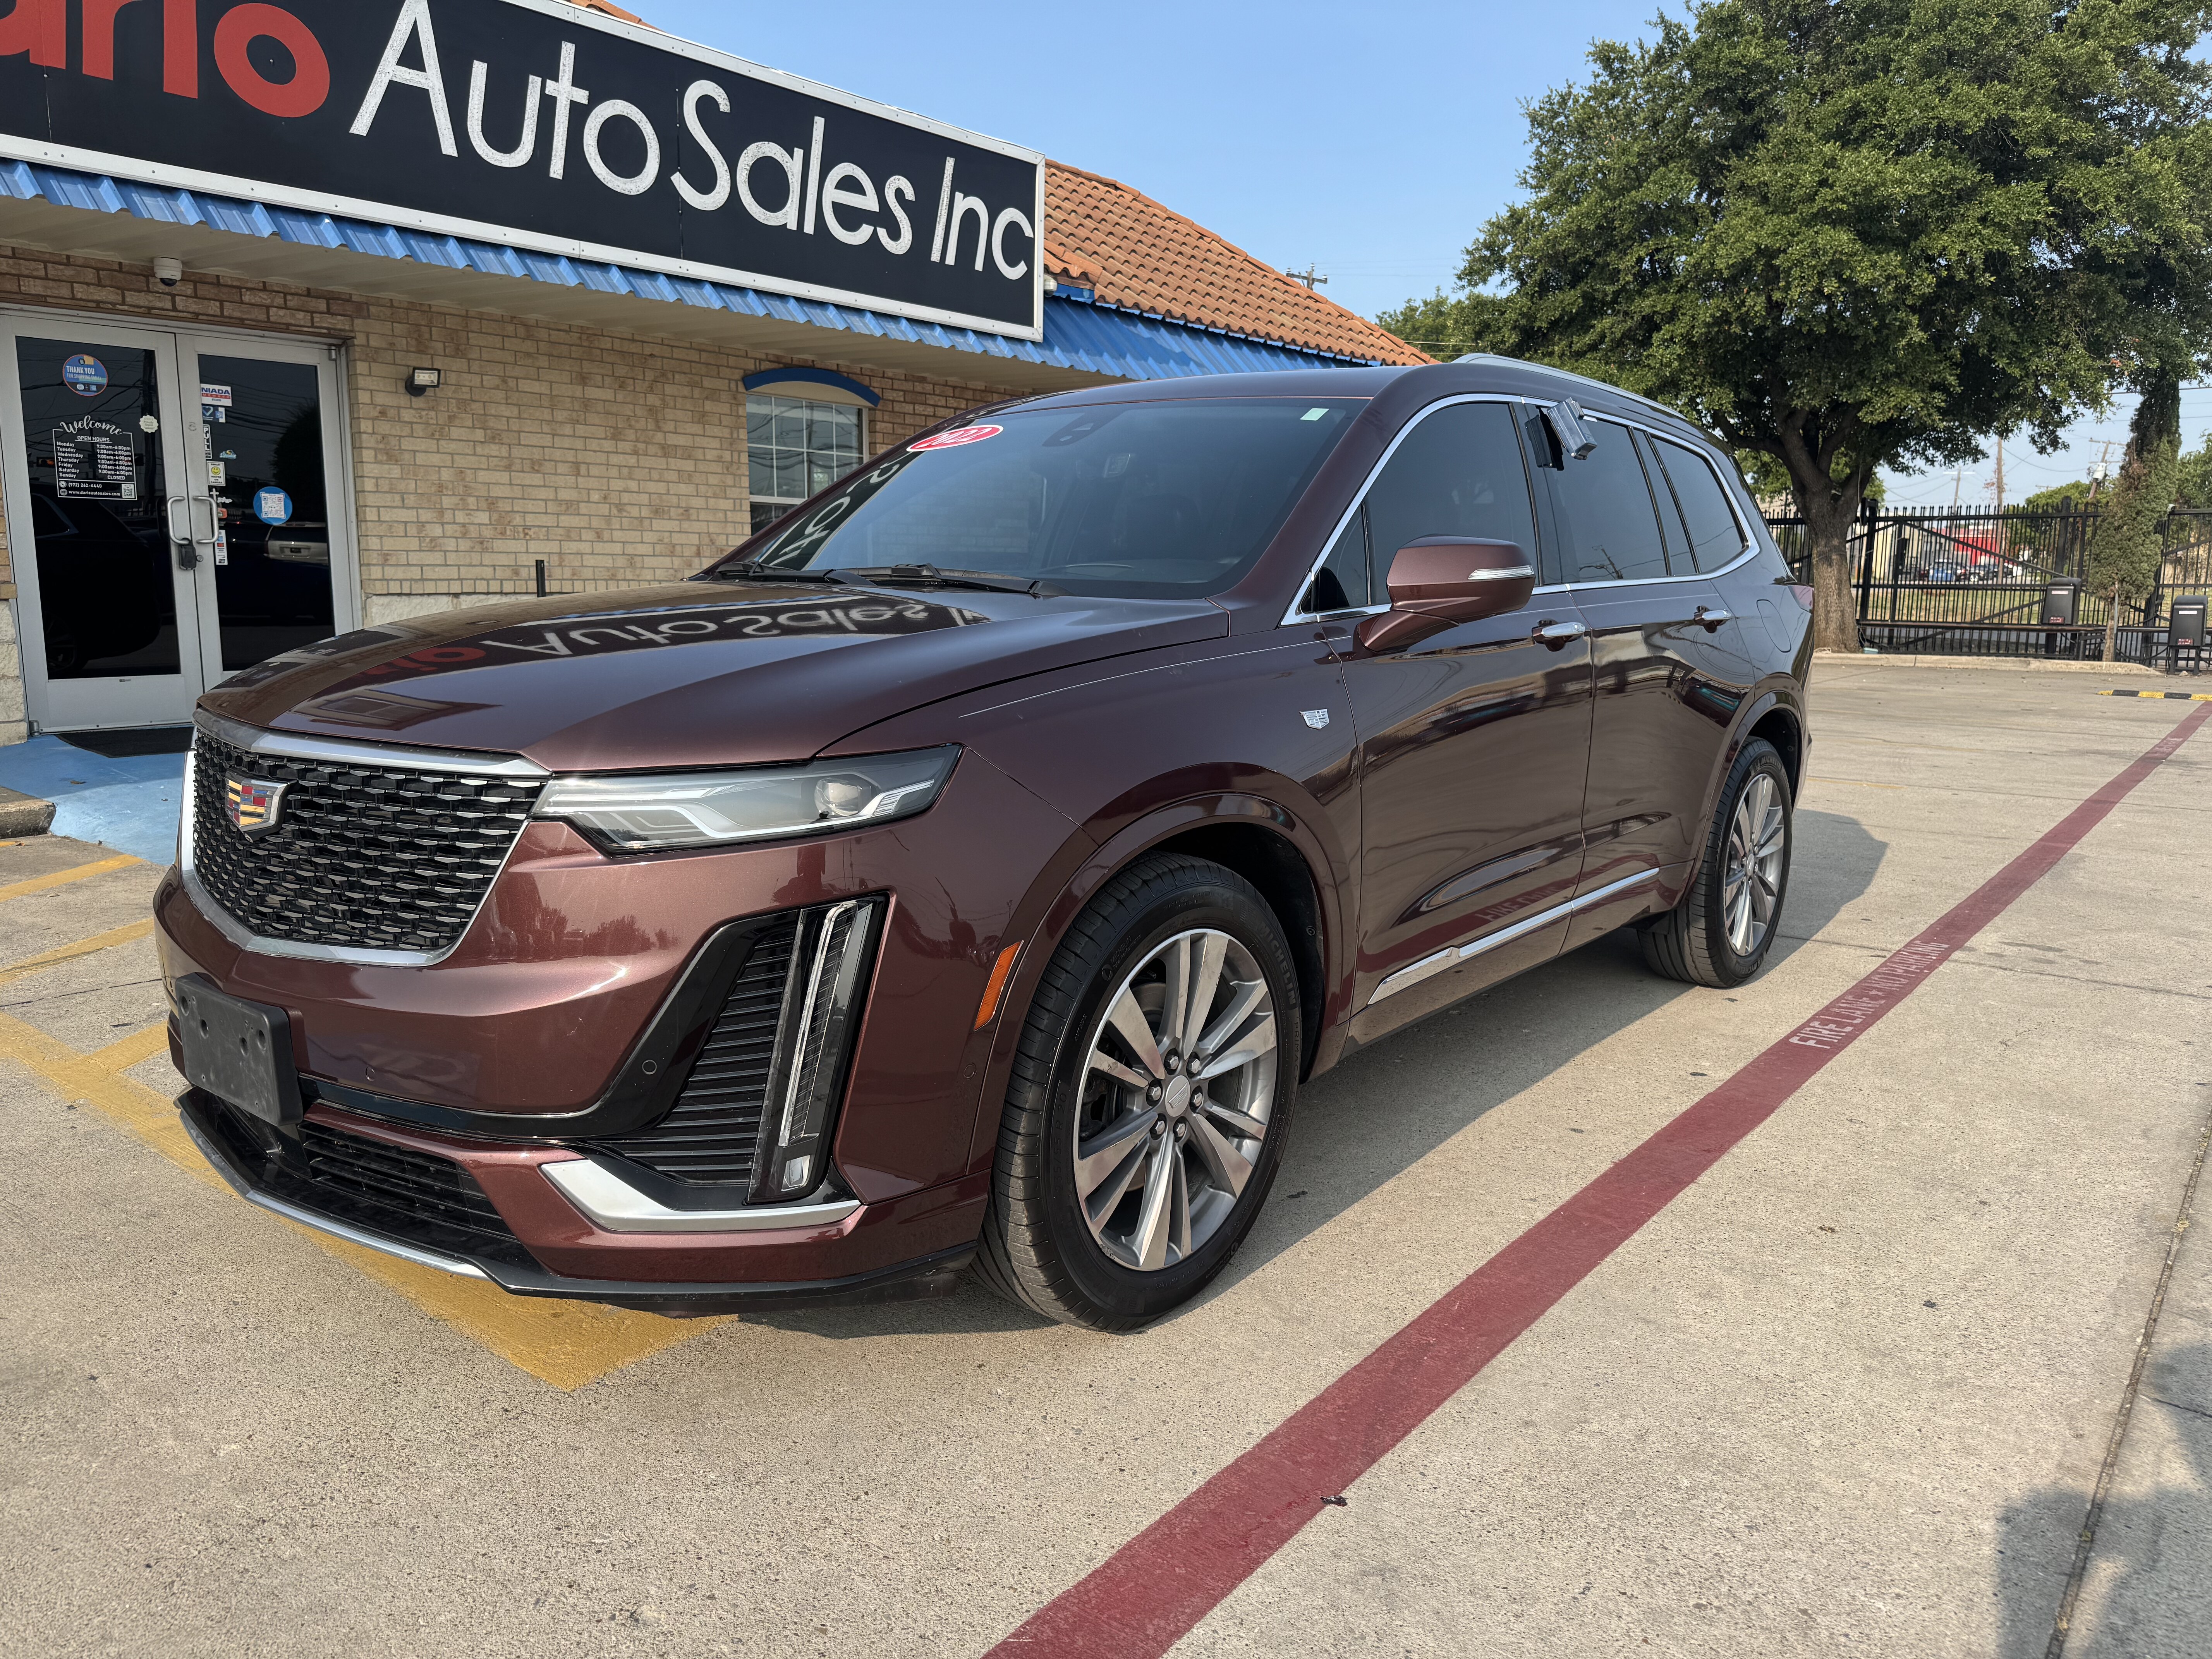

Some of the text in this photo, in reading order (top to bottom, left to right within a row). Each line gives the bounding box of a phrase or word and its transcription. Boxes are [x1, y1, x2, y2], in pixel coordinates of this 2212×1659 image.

[931, 157, 1034, 280] Inc
[67, 366, 84, 374] THANK
[60, 415, 122, 434] Welcome
[915, 428, 992, 449] 2022
[1110, 936, 1131, 964] MICHELIN
[1256, 921, 1297, 1005] MICHELIN
[1861, 974, 1911, 991] NO
[1815, 995, 1886, 1024] LANE
[1788, 1020, 1854, 1049] FIRE
[1286, 1091, 1295, 1127] TOUR
[1053, 1092, 1067, 1192] 235/55 R 20
